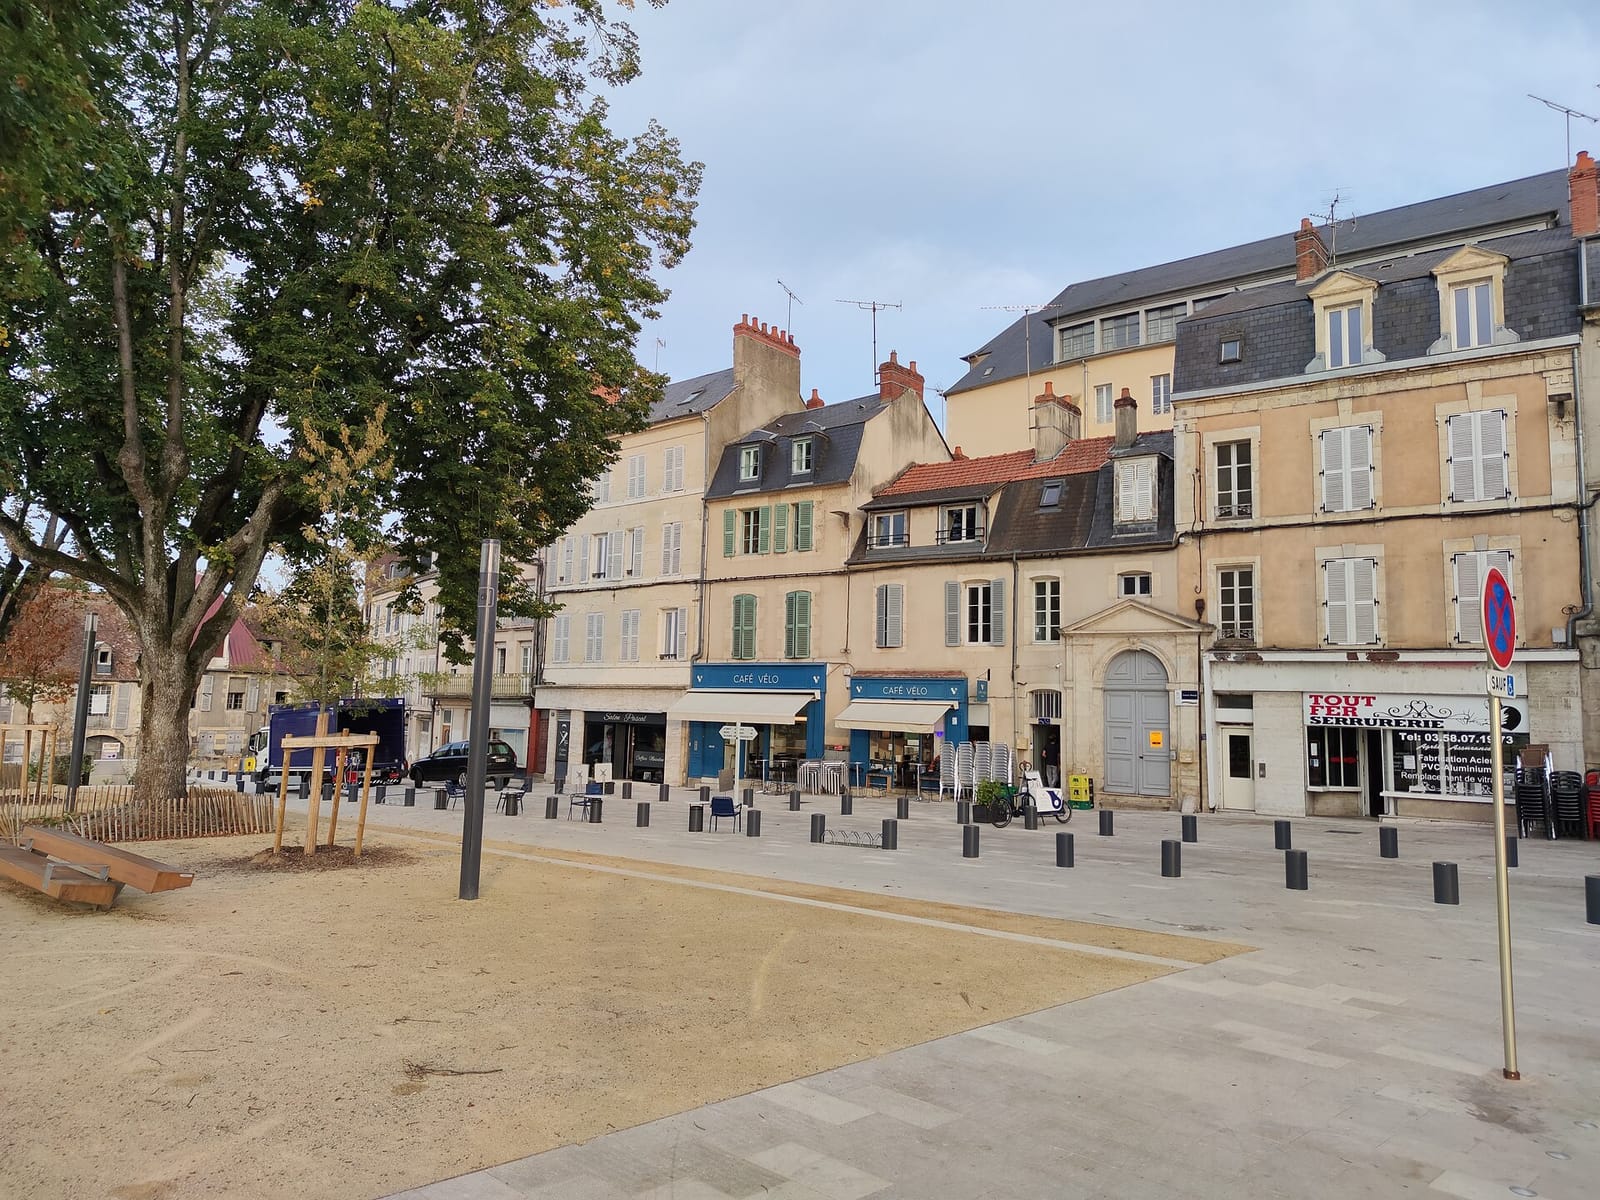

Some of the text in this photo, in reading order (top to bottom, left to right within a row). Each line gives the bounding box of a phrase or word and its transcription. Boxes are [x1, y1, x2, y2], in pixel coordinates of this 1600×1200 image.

[733, 673, 779, 683] CAFÉ VÉLO
[1491, 676, 1506, 691] SAUF
[882, 685, 928, 696] CAFÉ VÉLO
[1309, 694, 1376, 707] TOUT
[1309, 705, 1358, 716] FER
[1310, 716, 1444, 728] SERRURERIE
[1399, 732, 1421, 741] Tel:
[1418, 754, 1468, 763] Fabriation
[1421, 762, 1492, 773] PVC Aluminium
[1464, 775, 1475, 783] de
